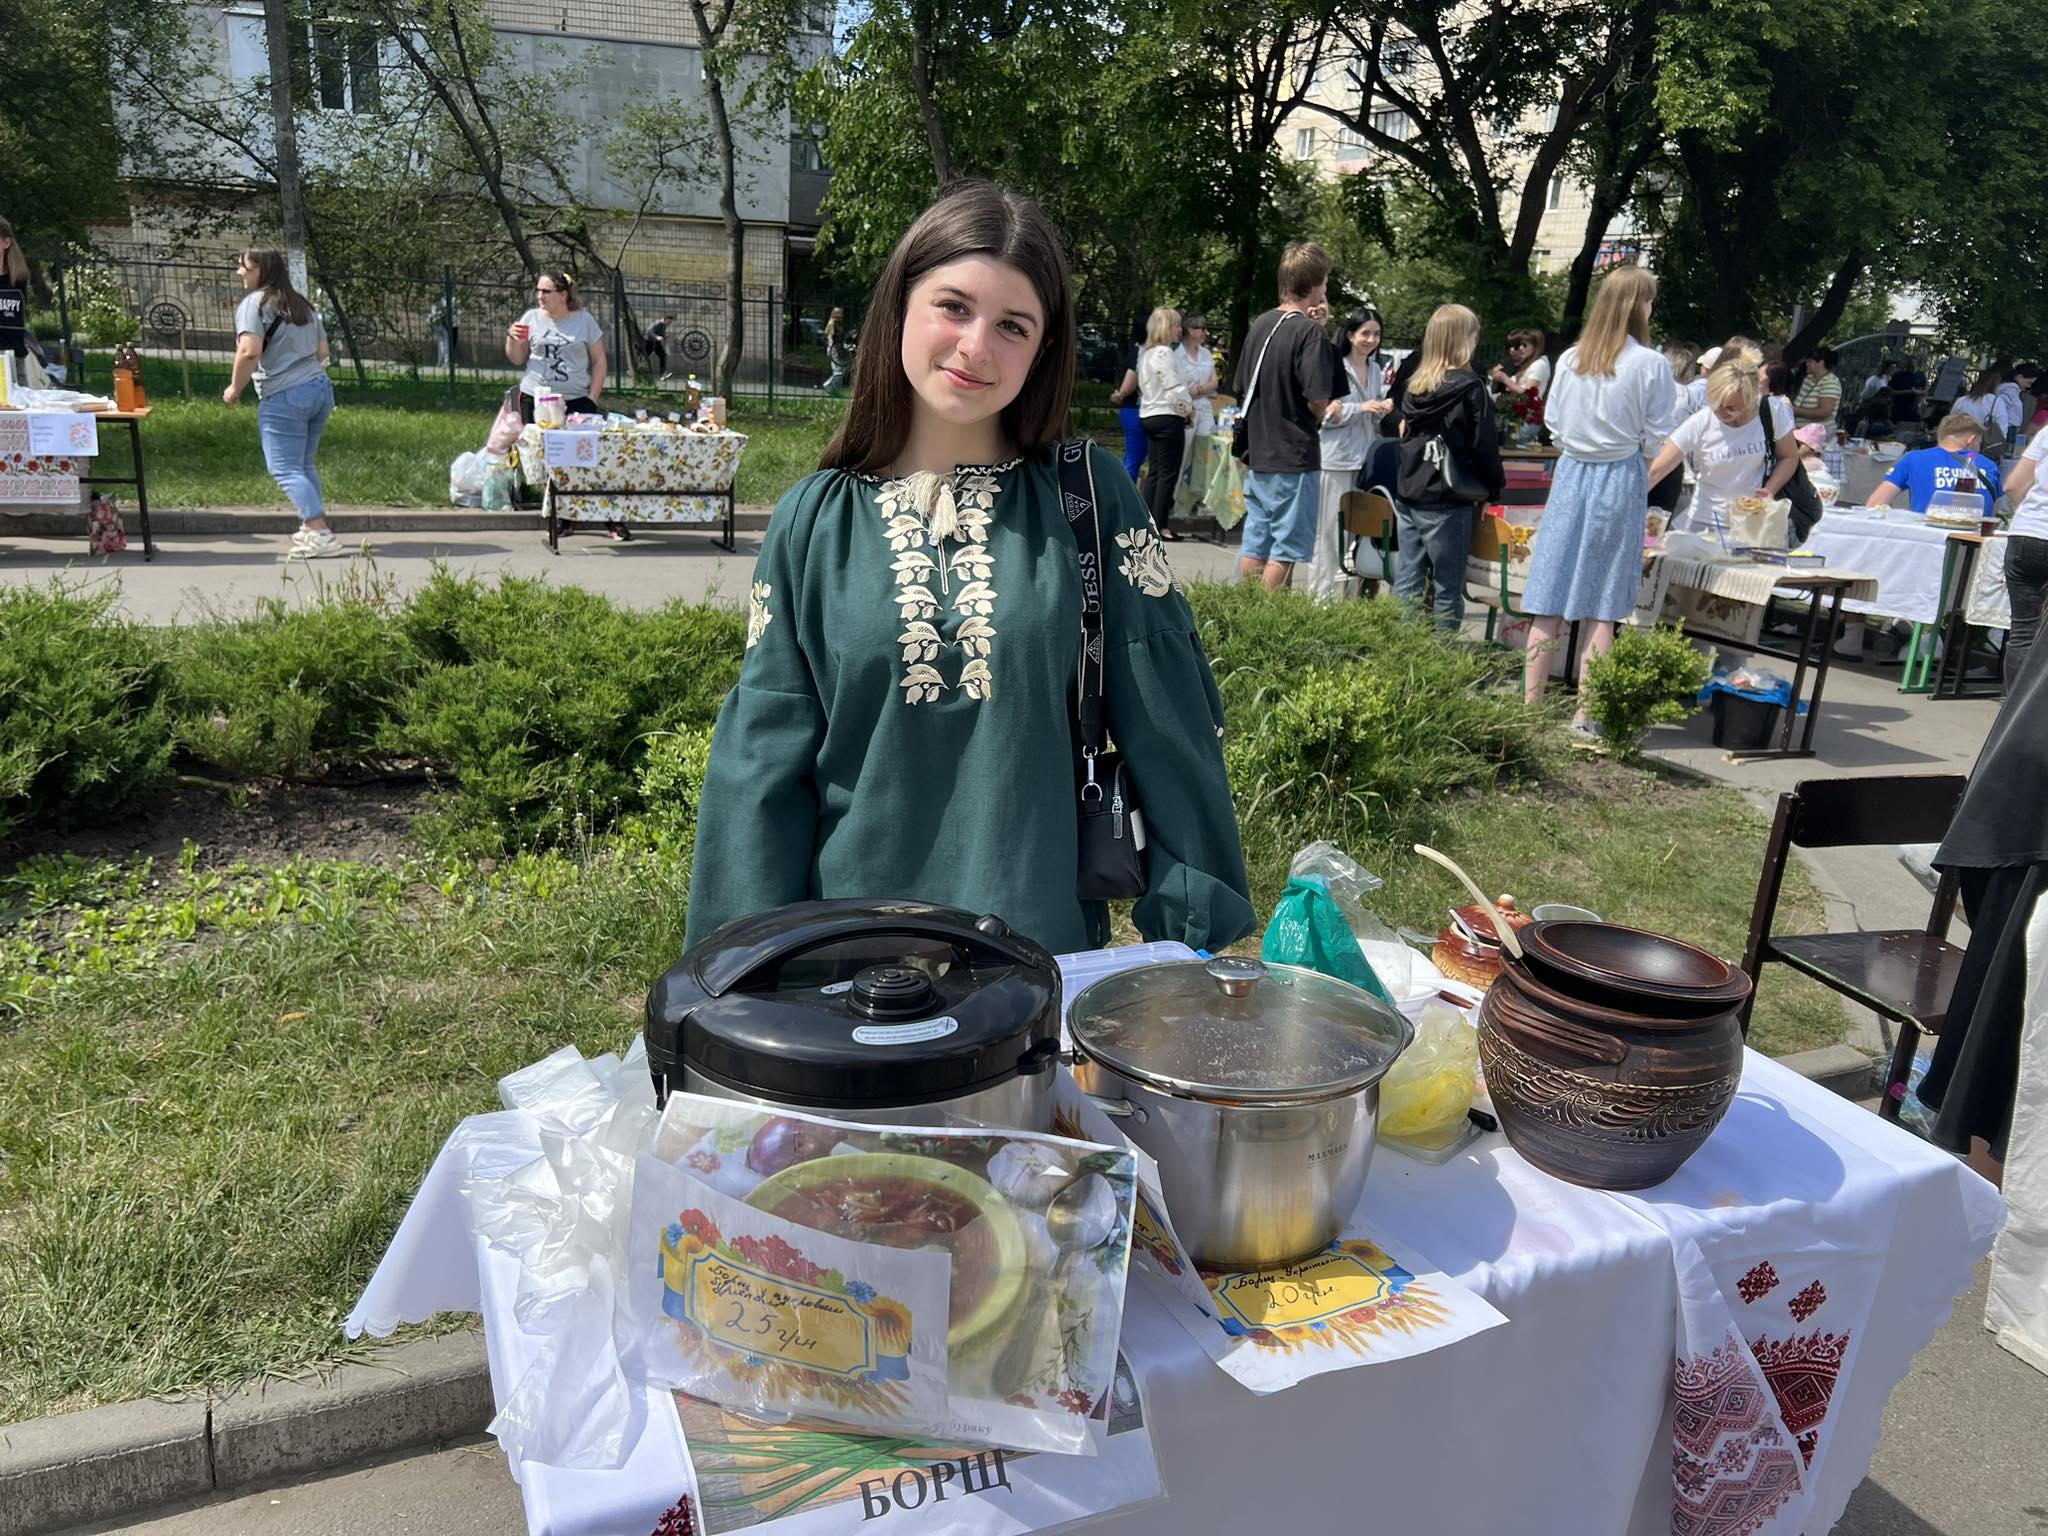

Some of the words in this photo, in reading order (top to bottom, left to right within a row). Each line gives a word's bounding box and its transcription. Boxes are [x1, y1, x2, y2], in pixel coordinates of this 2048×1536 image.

[1935, 466, 1950, 478] FC
[1079, 552, 1101, 613] UESS
[1232, 1270, 1276, 1290] Борщ
[1264, 1285, 1299, 1309] 20
[725, 1300, 778, 1335] 25
[856, 1449, 1013, 1521] БОРЩ
